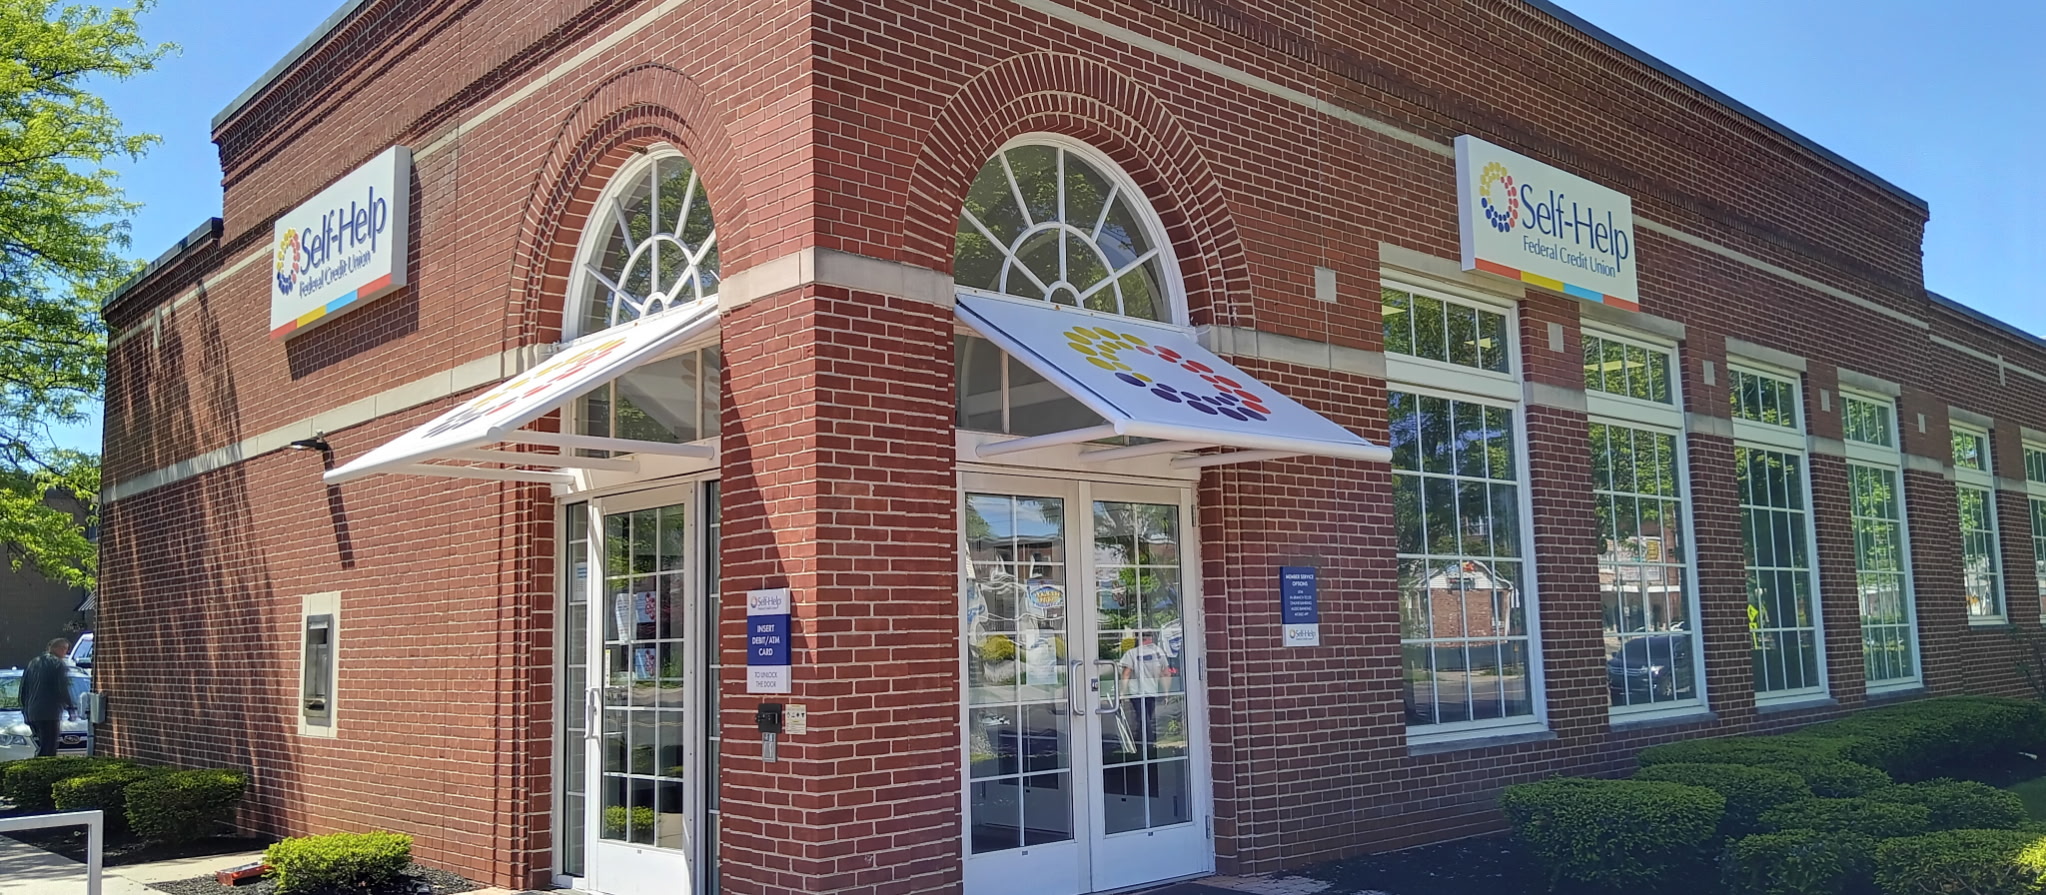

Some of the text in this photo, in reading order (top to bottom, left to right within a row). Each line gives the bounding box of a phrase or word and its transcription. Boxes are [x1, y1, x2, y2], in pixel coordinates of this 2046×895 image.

[300, 186, 387, 275] Self-Help
[1520, 184, 1629, 273] Self-Help
[299, 250, 371, 299] Federal Credit Union
[1523, 235, 1616, 278] Federal Credit Union
[758, 595, 782, 609] Self-Help
[752, 636, 780, 646] DEBIT/ATM
[757, 624, 775, 632] INSERT
